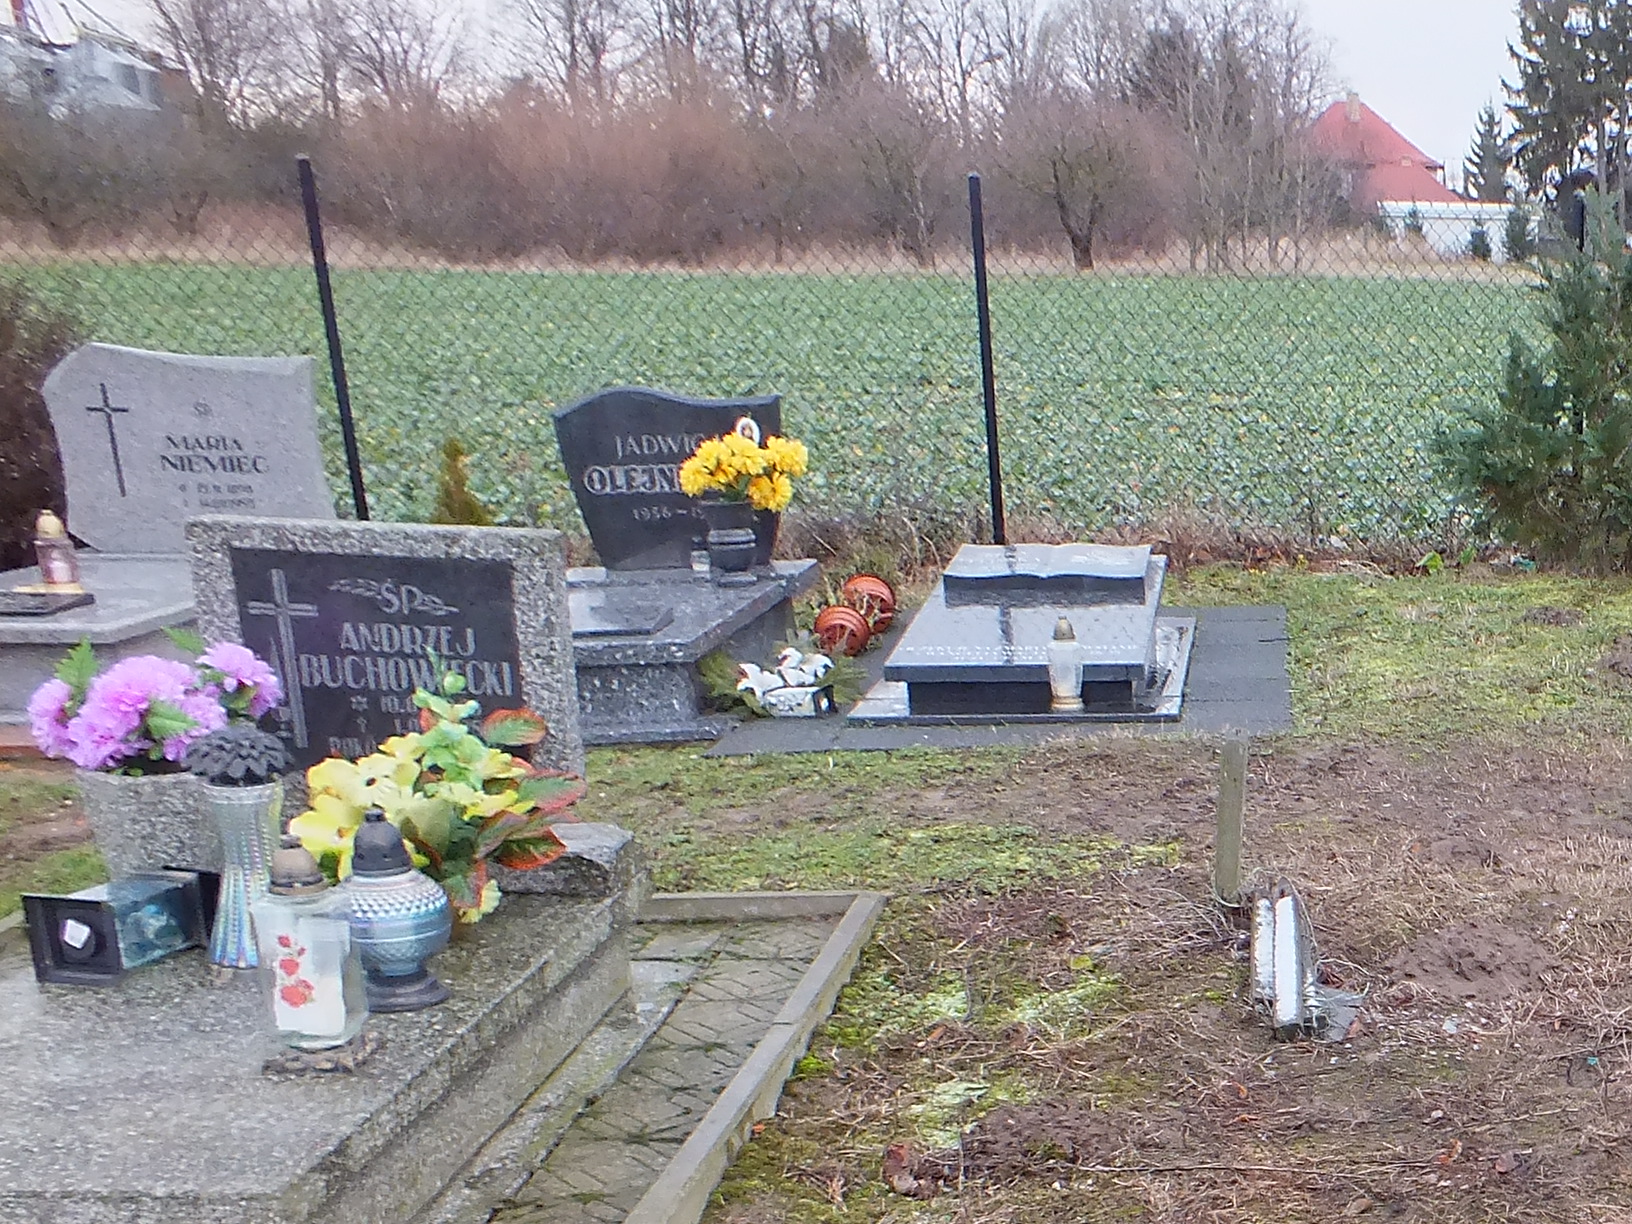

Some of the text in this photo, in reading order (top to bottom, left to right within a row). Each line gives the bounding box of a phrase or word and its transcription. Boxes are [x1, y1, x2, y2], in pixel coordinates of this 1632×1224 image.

[166, 434, 243, 451] MARIA
[160, 454, 270, 474] NIEMIEC
[340, 621, 476, 656] ANDRZEJ
[300, 655, 513, 697] BUCHOWCKI
